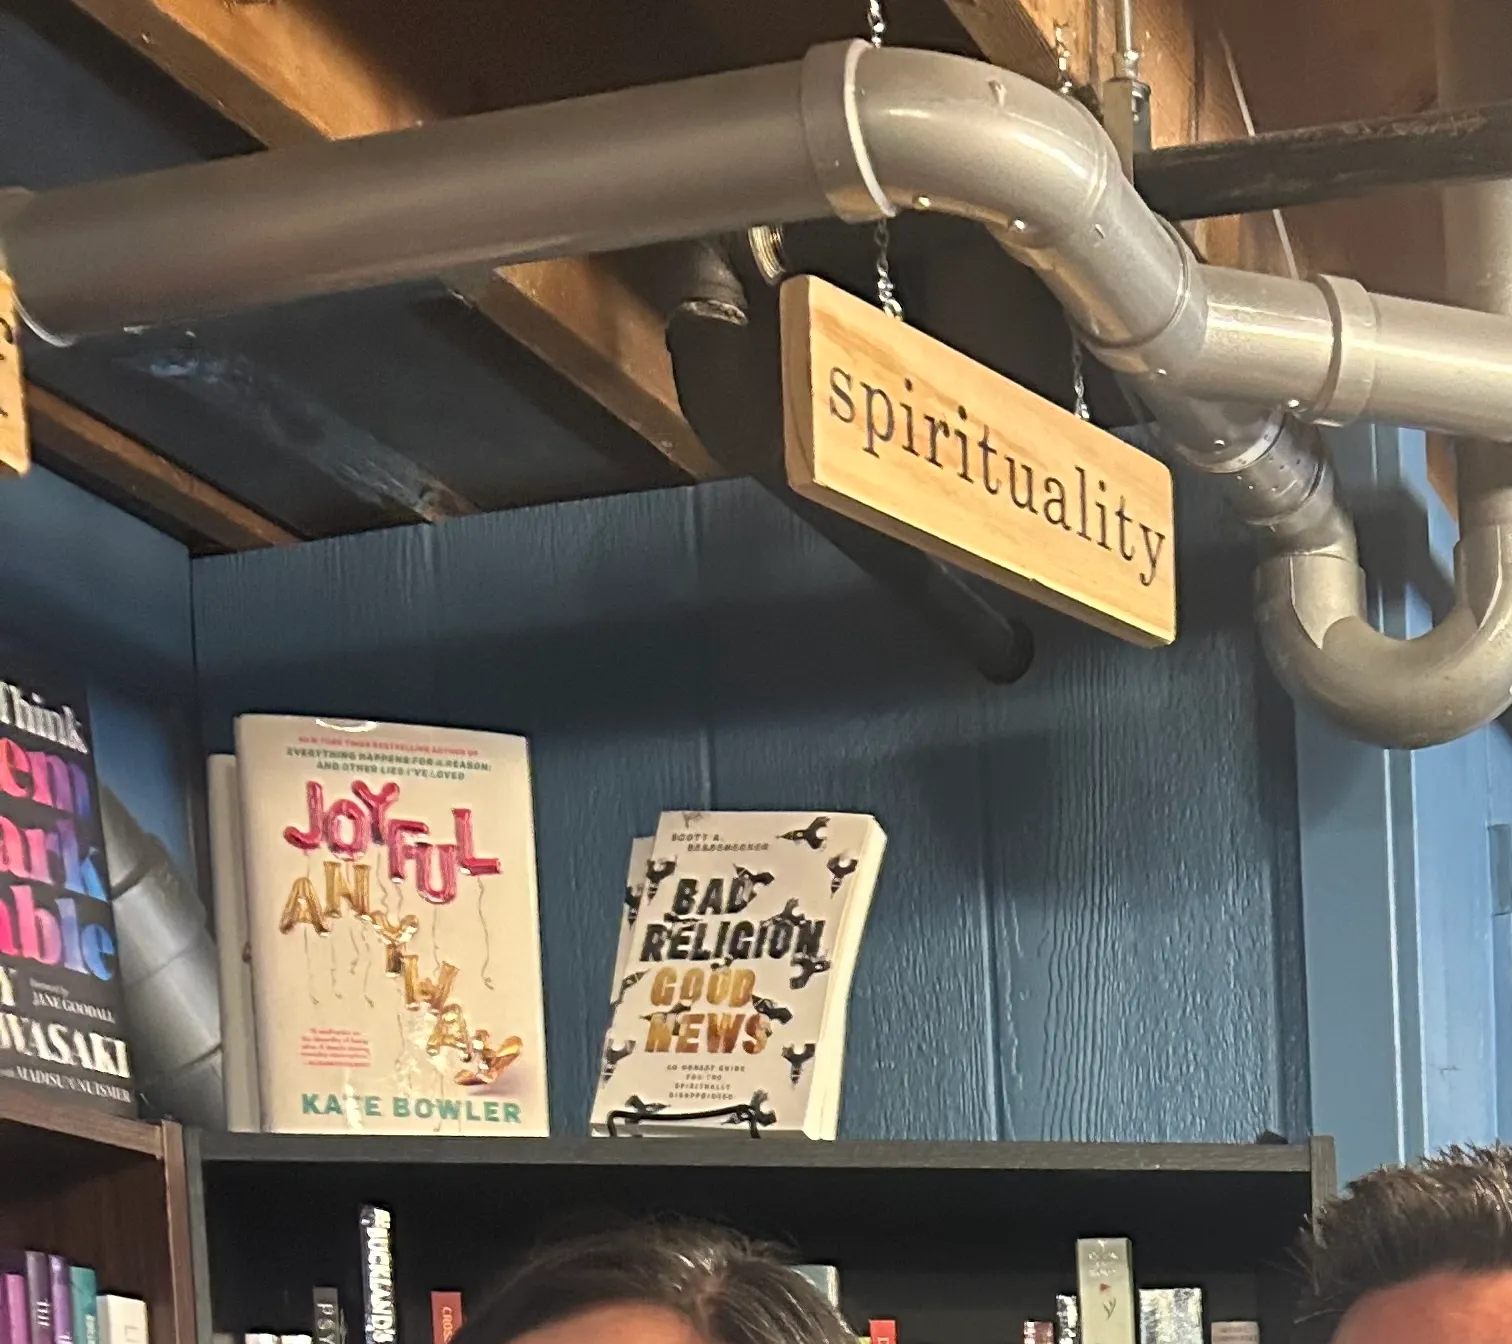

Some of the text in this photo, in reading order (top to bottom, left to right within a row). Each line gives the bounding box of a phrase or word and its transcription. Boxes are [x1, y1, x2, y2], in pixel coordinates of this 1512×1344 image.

[828, 366, 1167, 588] spirituality
[287, 746, 356, 761] EVERYTHING
[359, 752, 409, 765] HAPPENS
[411, 755, 432, 766] FOR
[316, 760, 339, 771] AND
[342, 762, 378, 774] OTHER
[380, 765, 404, 776] LIES
[431, 769, 465, 781] LOVED
[0, 737, 92, 821] em
[283, 779, 503, 905] JOYFUL
[671, 878, 757, 916] BAD
[0, 885, 115, 981] ble
[639, 919, 826, 962] RELIGION
[651, 967, 757, 1007] GOOD
[63, 998, 115, 1024] GOODALL
[645, 1013, 772, 1055] NEWS
[392, 1097, 522, 1124] BOWLER
[366, 1226, 395, 1344] BUCKLAND'S
